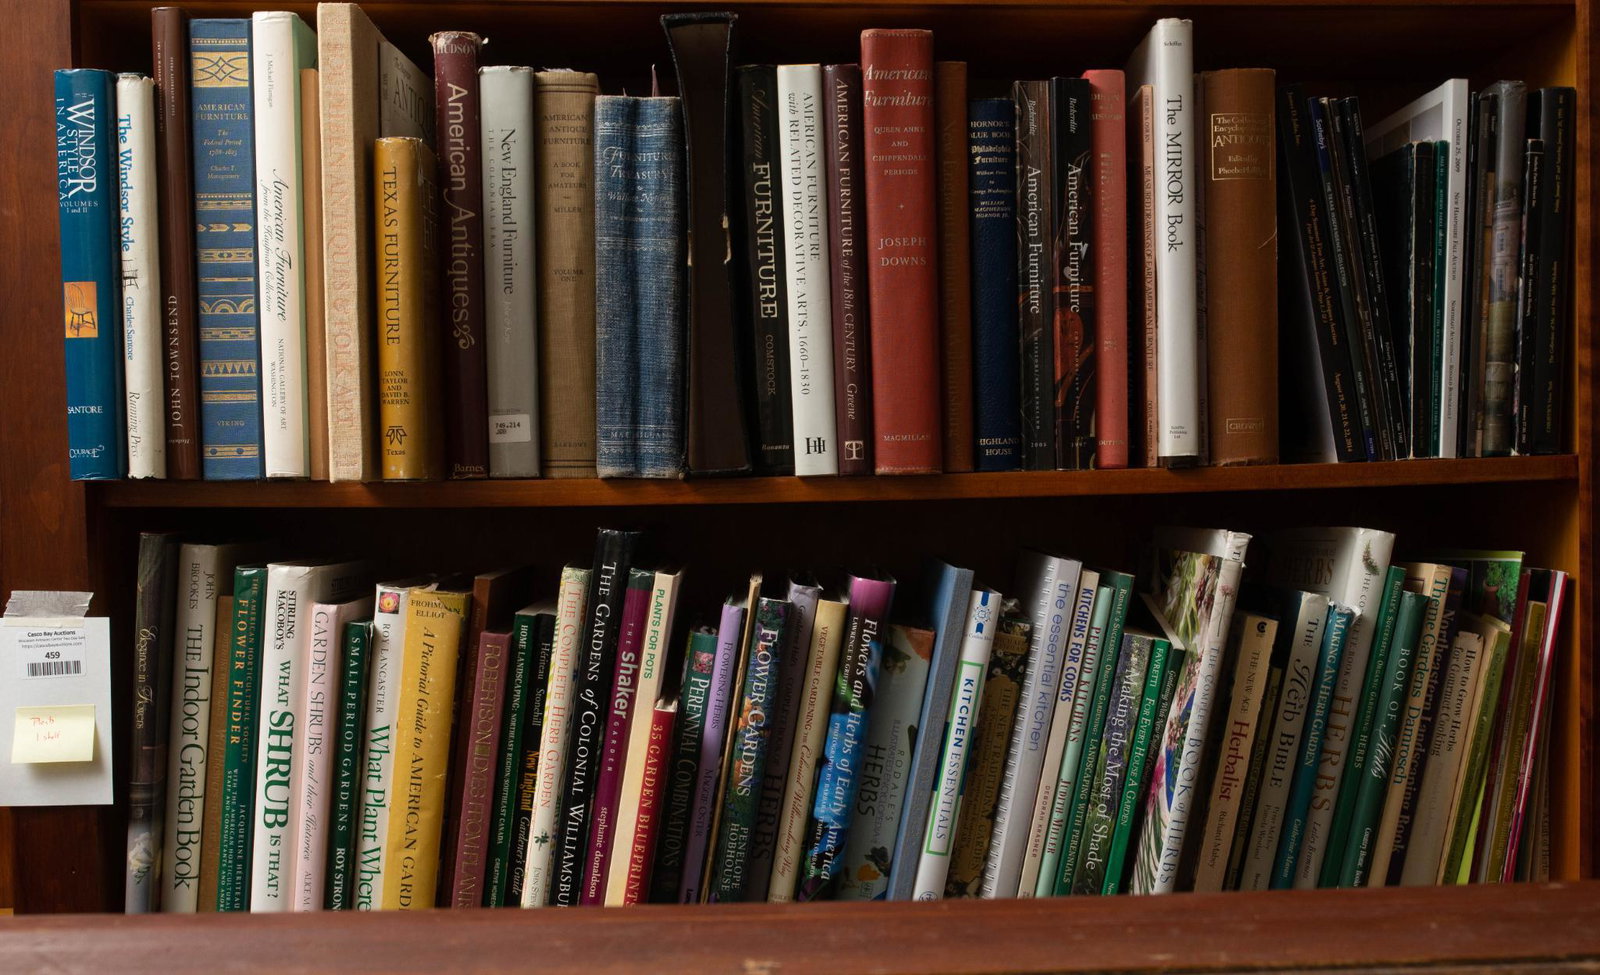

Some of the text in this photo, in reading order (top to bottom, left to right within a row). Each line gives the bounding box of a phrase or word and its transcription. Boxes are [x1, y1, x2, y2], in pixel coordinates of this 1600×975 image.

[56, 97, 66, 116] IN
[196, 113, 249, 121] FURNITURE
[500, 128, 517, 165] New
[545, 113, 591, 121] AMERICAN
[874, 126, 900, 135] QUEEN
[1028, 100, 1038, 137] Beckerdite
[1068, 97, 1078, 134] Beckerdite
[66, 130, 77, 172] STYLE
[67, 99, 97, 199] WINDSOR
[118, 114, 135, 252] The Windsor Style
[788, 92, 807, 286] with RELATED DECORATIVE
[802, 92, 820, 262] AMERICAN FURNITURE
[1166, 94, 1184, 254] The MIRROR Book
[444, 82, 477, 325] American Antiques
[498, 166, 518, 226] England
[836, 78, 857, 373] AMERICAN FURNITURE the CENTURY
[1067, 162, 1084, 236] American
[260, 179, 274, 313] from the Collection
[272, 168, 293, 323] American Furniture
[383, 166, 401, 346] TEXAS FURNITURE
[501, 228, 518, 295] Furniture
[750, 82, 779, 397] American FURNITURE COMSTOCK
[877, 236, 927, 250] JOSEPH
[1027, 165, 1044, 314] American Furniture
[1069, 240, 1085, 313] Furniture
[1144, 166, 1154, 371] MEASURED DRAWINGS FURNITURE
[126, 296, 136, 361] Charles Santore
[168, 295, 180, 381] TOWNSEND
[277, 338, 287, 373] NATIONAL
[67, 405, 104, 414] SANTORE
[171, 388, 181, 427] JOHN
[269, 361, 278, 408] WASHINGTON
[453, 463, 485, 473] Barnes
[189, 562, 201, 610] BROOKES
[204, 571, 216, 600] JOHN
[285, 590, 297, 639] STIRLING
[415, 609, 446, 619] ELLIOT
[45, 651, 61, 659] 459
[53, 629, 76, 637] Auctions
[230, 599, 248, 745] FLOWER FINDER
[643, 588, 666, 680] PLANTS FOR POTS
[1027, 582, 1072, 752] the essential kitchen
[1059, 587, 1094, 702] KITCHENS FOR COOKS
[1303, 617, 1320, 648] THE
[1326, 616, 1347, 664] MAKING
[1392, 647, 1411, 692] BOOK
[244, 646, 254, 721] HORTICULTURAL
[571, 560, 618, 796] THE GARDENS COLONIAL
[711, 641, 734, 729] FLOWERING HERBS
[736, 627, 780, 797] FLOWER GARDENS
[803, 626, 829, 731] VEGETABLE GARDENING
[1282, 658, 1311, 722] Herb
[1393, 577, 1450, 785] Theme Gardens Damrosch
[1445, 649, 1477, 752] How Grow Herbs
[174, 624, 209, 891] THE Indoor Garden Book
[263, 659, 296, 830] WHAT SHRUB
[303, 610, 330, 861] GARDEN SHRUBS Histories
[338, 637, 361, 832] SMALL PERIOD GARDENS
[362, 623, 392, 843] ROY What Plant
[403, 641, 435, 852] Pictorial Guide to AMERICAN
[588, 649, 639, 898] shaker donaldson
[662, 676, 711, 867] PERENNIAL COMBINATIONS
[820, 617, 879, 881] Flowers and America
[935, 677, 975, 840] KITCHEN ESSENTIALS
[1218, 719, 1250, 801] Herbalist
[1269, 731, 1296, 788] BIBLE
[1310, 695, 1354, 812] HERBS
[496, 713, 517, 845] NORTHEAST CANADA
[641, 744, 662, 808] GARDEN
[857, 744, 887, 817] HERBS
[1085, 759, 1122, 871] Most Shade
[1175, 802, 1185, 813] of
[236, 804, 246, 861] JACQUELINE
[720, 822, 740, 892] HOBHOUSE
